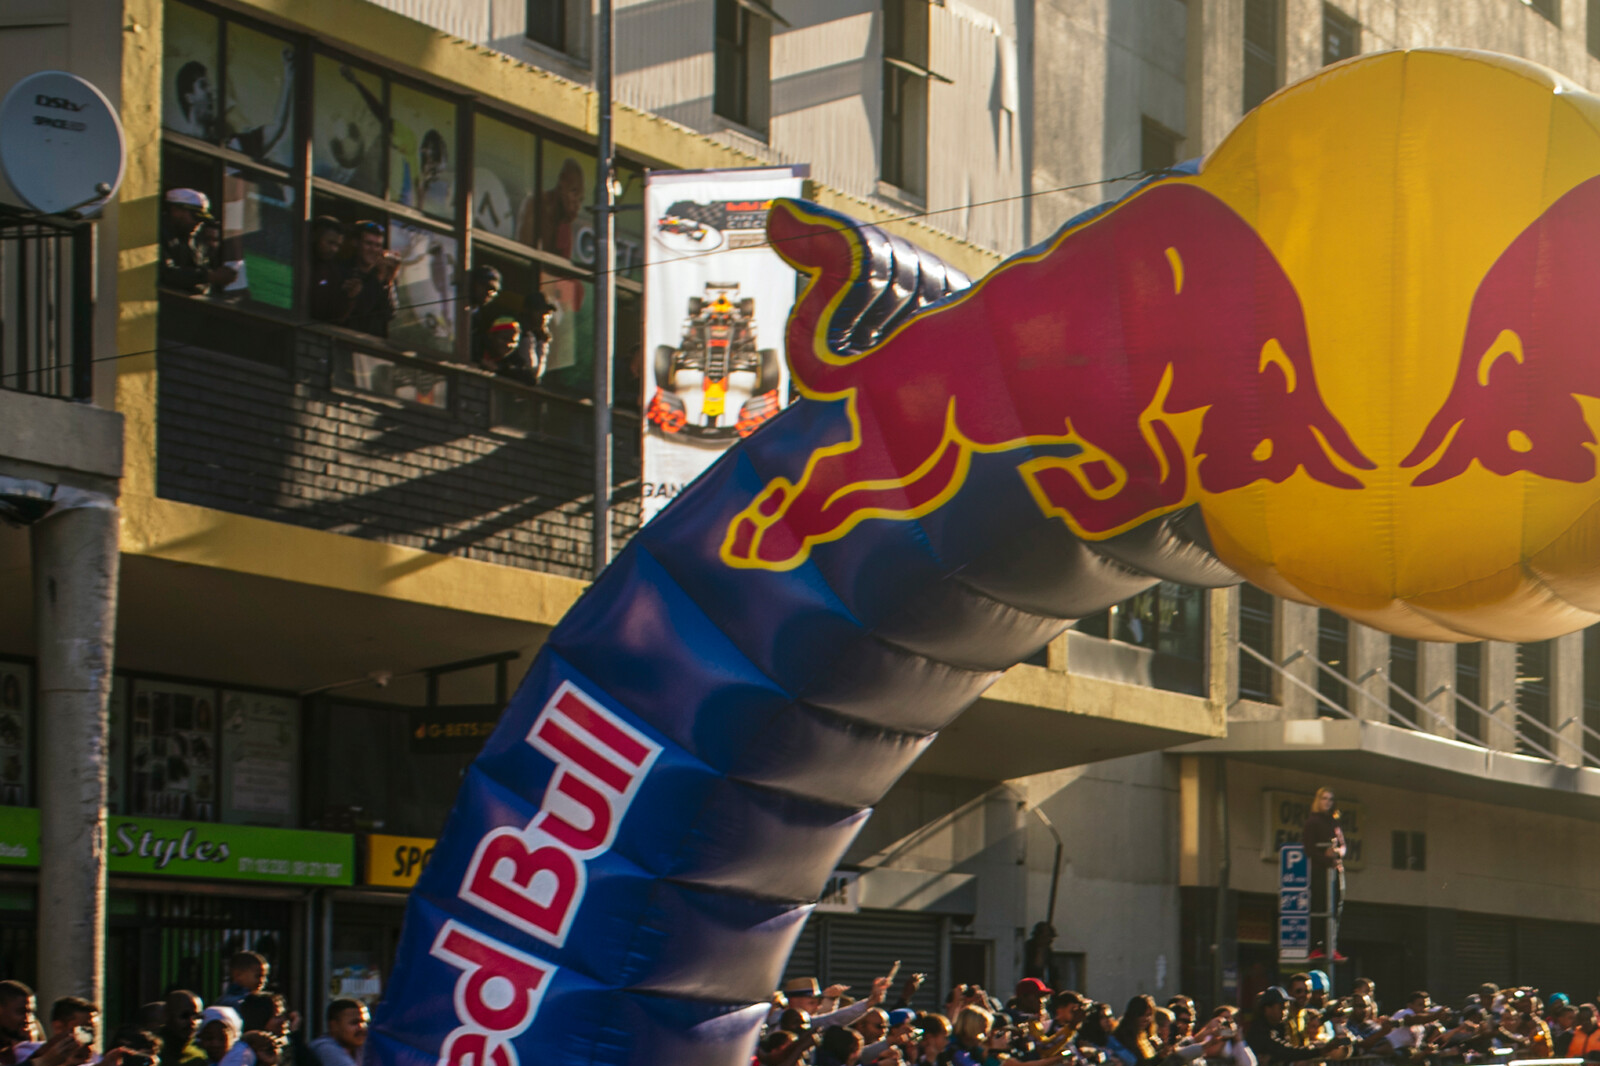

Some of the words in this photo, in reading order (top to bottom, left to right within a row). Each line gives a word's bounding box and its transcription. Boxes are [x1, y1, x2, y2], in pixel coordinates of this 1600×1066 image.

[463, 685, 658, 943] Bull
[110, 822, 230, 869] Styles
[1286, 850, 1303, 869] P
